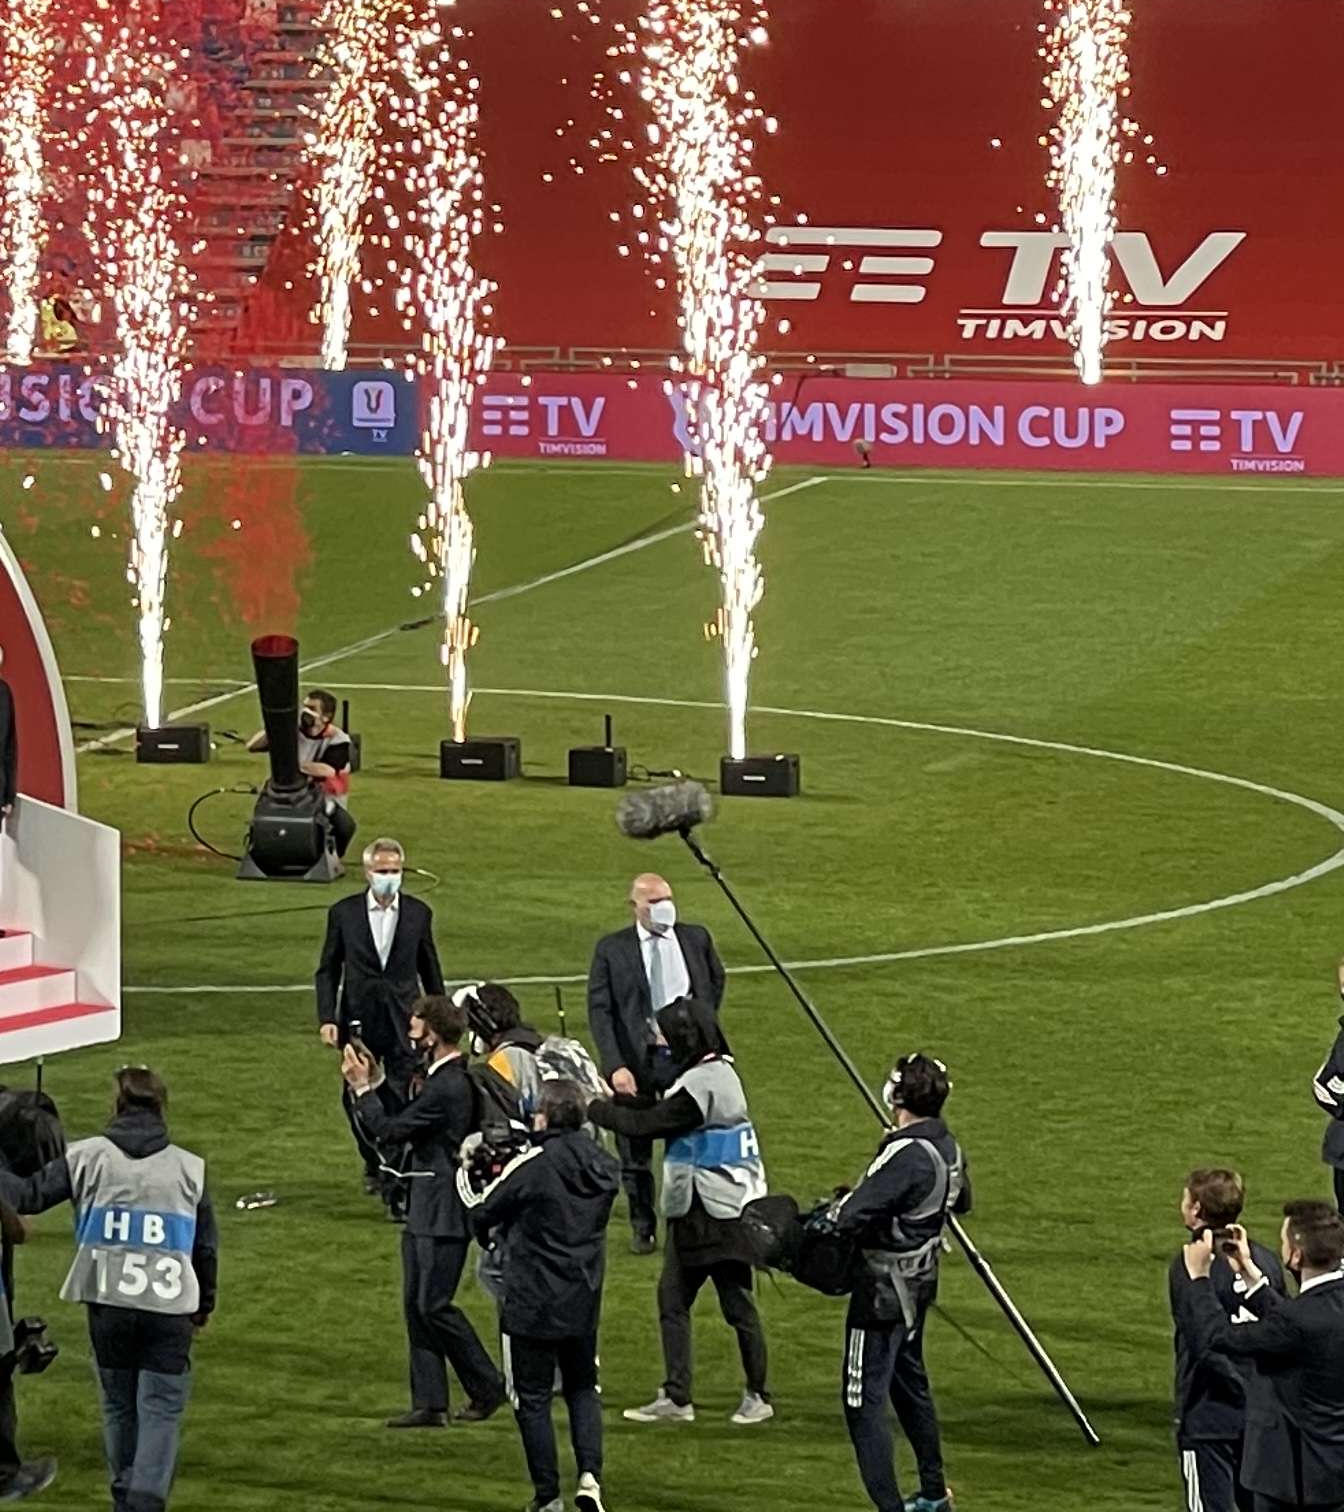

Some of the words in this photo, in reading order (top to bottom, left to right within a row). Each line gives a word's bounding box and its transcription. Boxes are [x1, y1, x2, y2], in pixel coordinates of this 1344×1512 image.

[979, 231, 1247, 306] TV
[189, 376, 313, 427] CUP
[538, 396, 606, 438] TV
[539, 442, 606, 456] TIMVISION
[1018, 406, 1125, 450] CUP
[1231, 410, 1304, 453] TV
[1231, 459, 1305, 473] TIMVISION
[92, 1248, 183, 1300] 153
